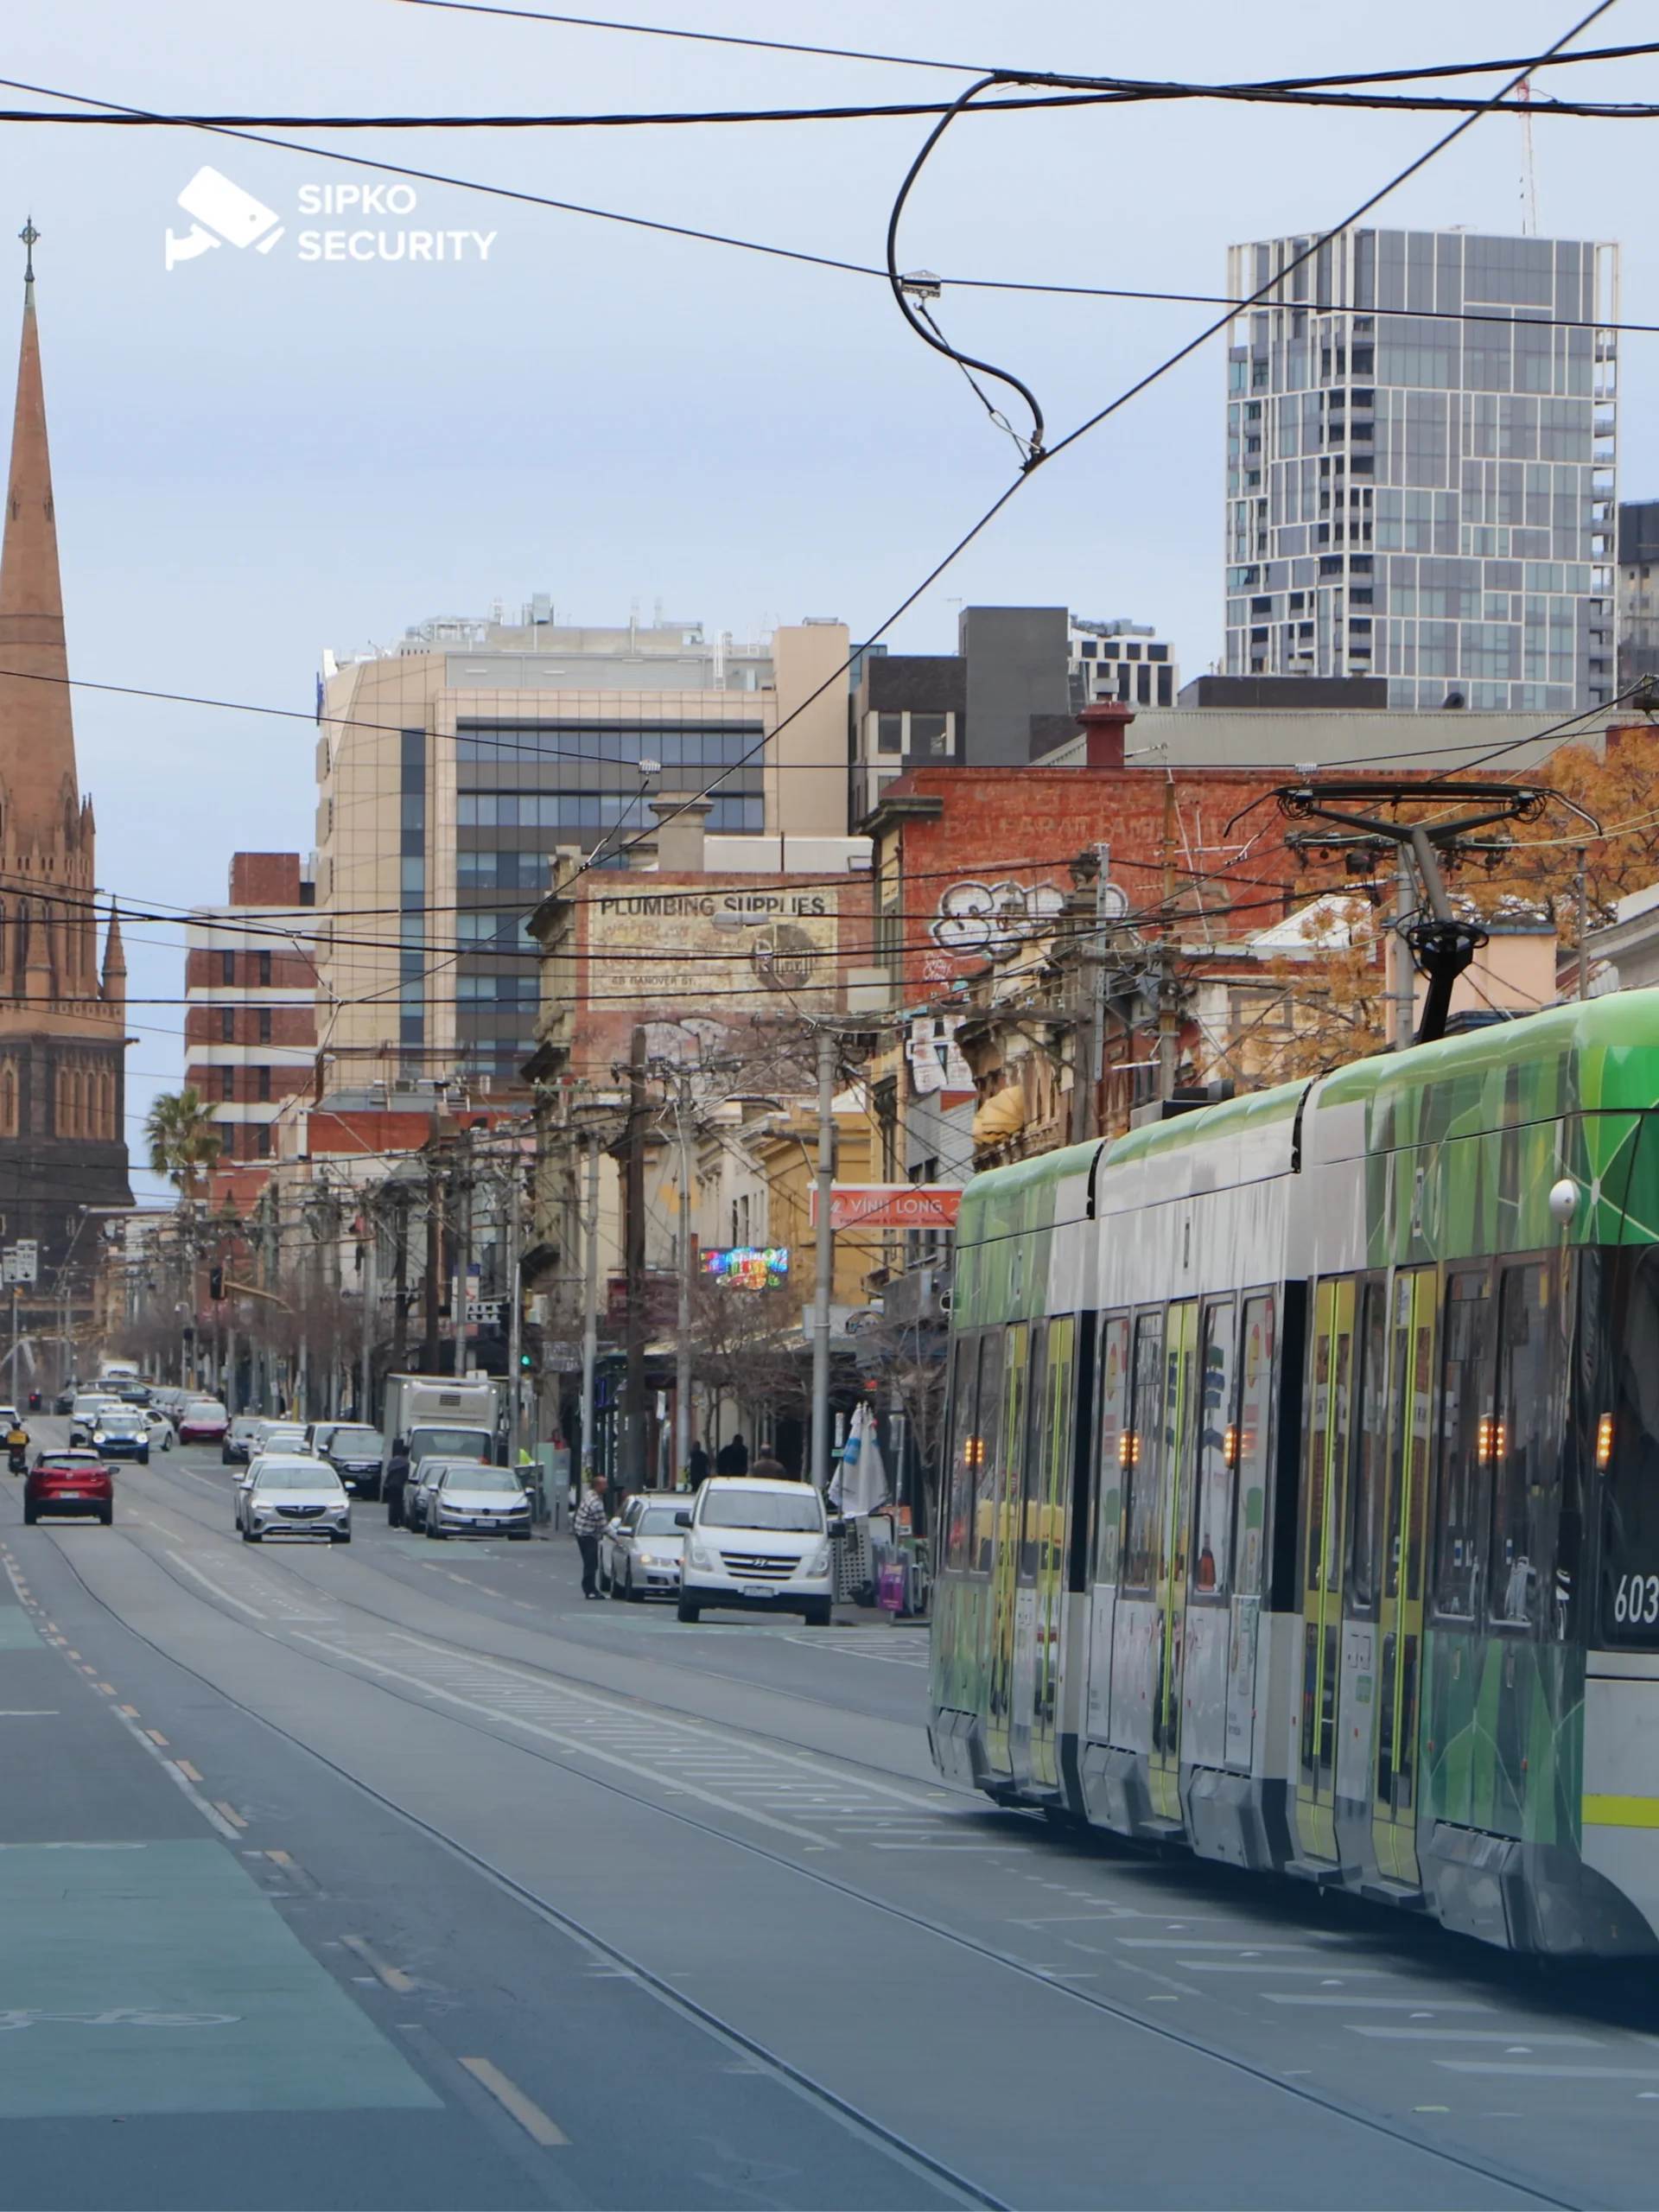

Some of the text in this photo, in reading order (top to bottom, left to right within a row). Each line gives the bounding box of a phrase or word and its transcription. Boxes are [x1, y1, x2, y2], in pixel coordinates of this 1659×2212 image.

[601, 896, 826, 916] PLUMBING SUPPLIES
[895, 1198, 943, 1214] LONG
